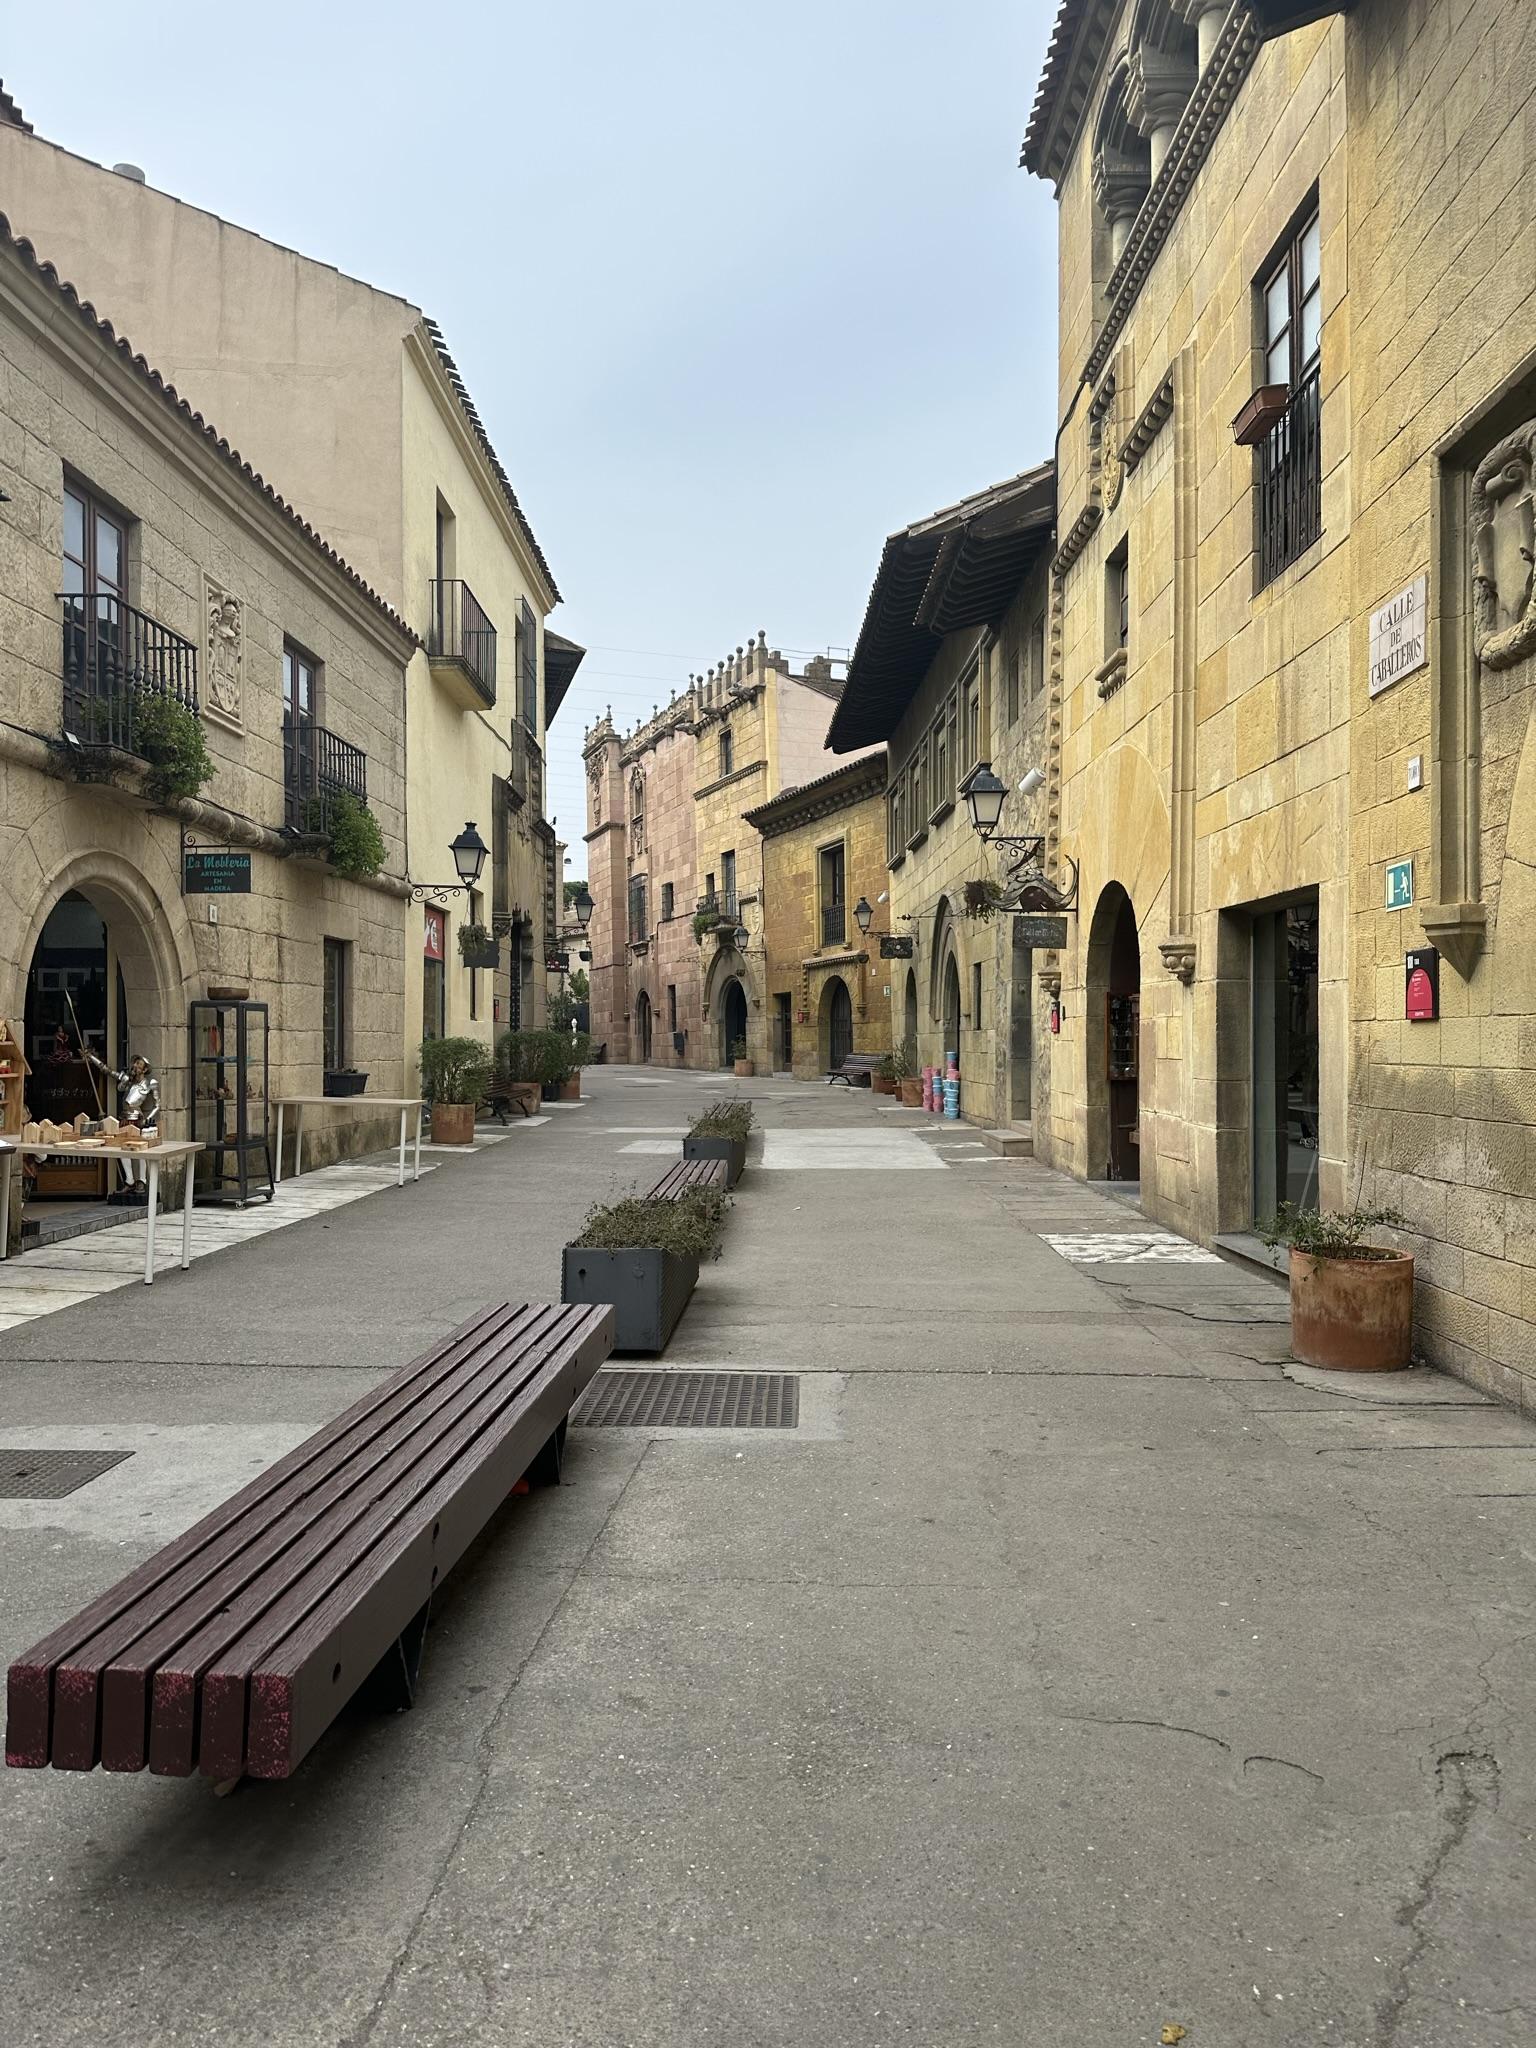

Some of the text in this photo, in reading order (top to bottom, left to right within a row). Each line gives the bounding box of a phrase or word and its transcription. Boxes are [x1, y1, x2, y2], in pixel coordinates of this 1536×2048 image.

[1379, 591, 1414, 632] CALLE
[1390, 627, 1402, 648] DE
[1371, 634, 1422, 687] CABALLEROS
[187, 856, 200, 869] La
